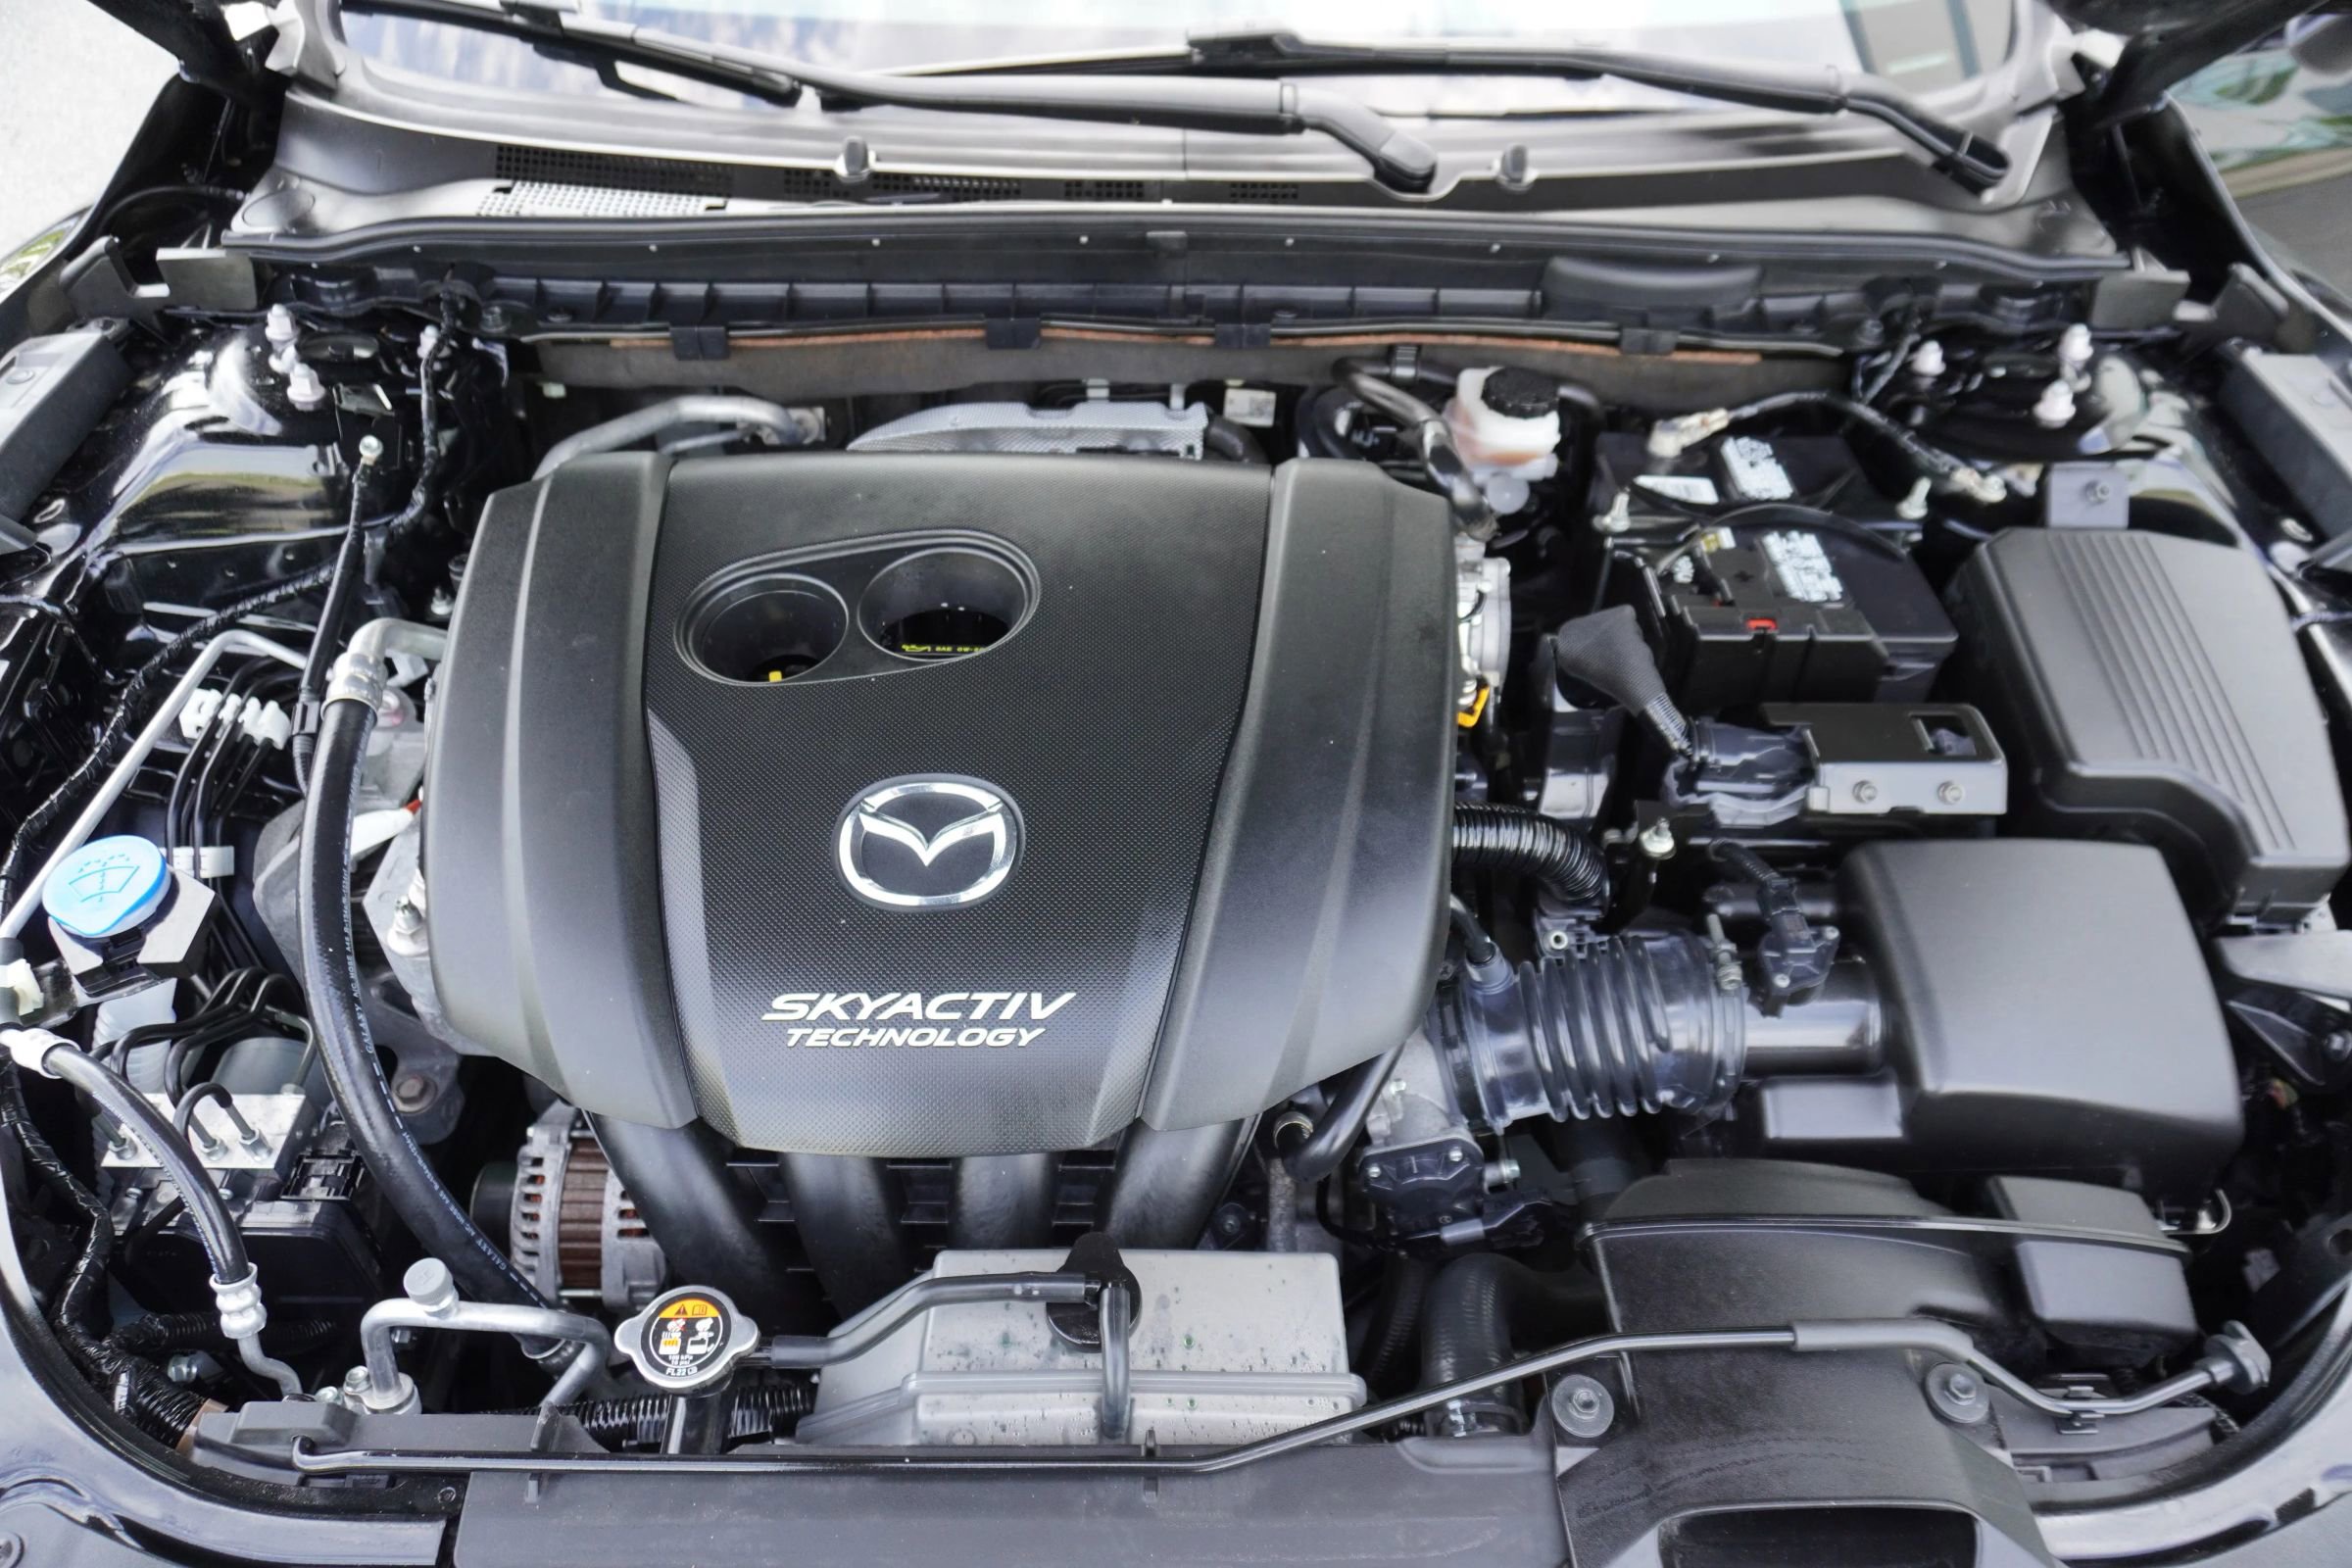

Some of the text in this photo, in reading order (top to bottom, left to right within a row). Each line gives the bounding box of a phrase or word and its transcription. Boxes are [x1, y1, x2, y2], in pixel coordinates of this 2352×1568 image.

[346, 955, 356, 979] HOSE
[761, 992, 1076, 1020] SKYACTIV
[354, 1003, 373, 1054] GALAXY
[787, 1028, 1046, 1047] TECHNOLOGY
[449, 1204, 466, 1224] HOSE
[475, 1238, 508, 1270] GALAXY
[666, 1367, 686, 1376] FL22
